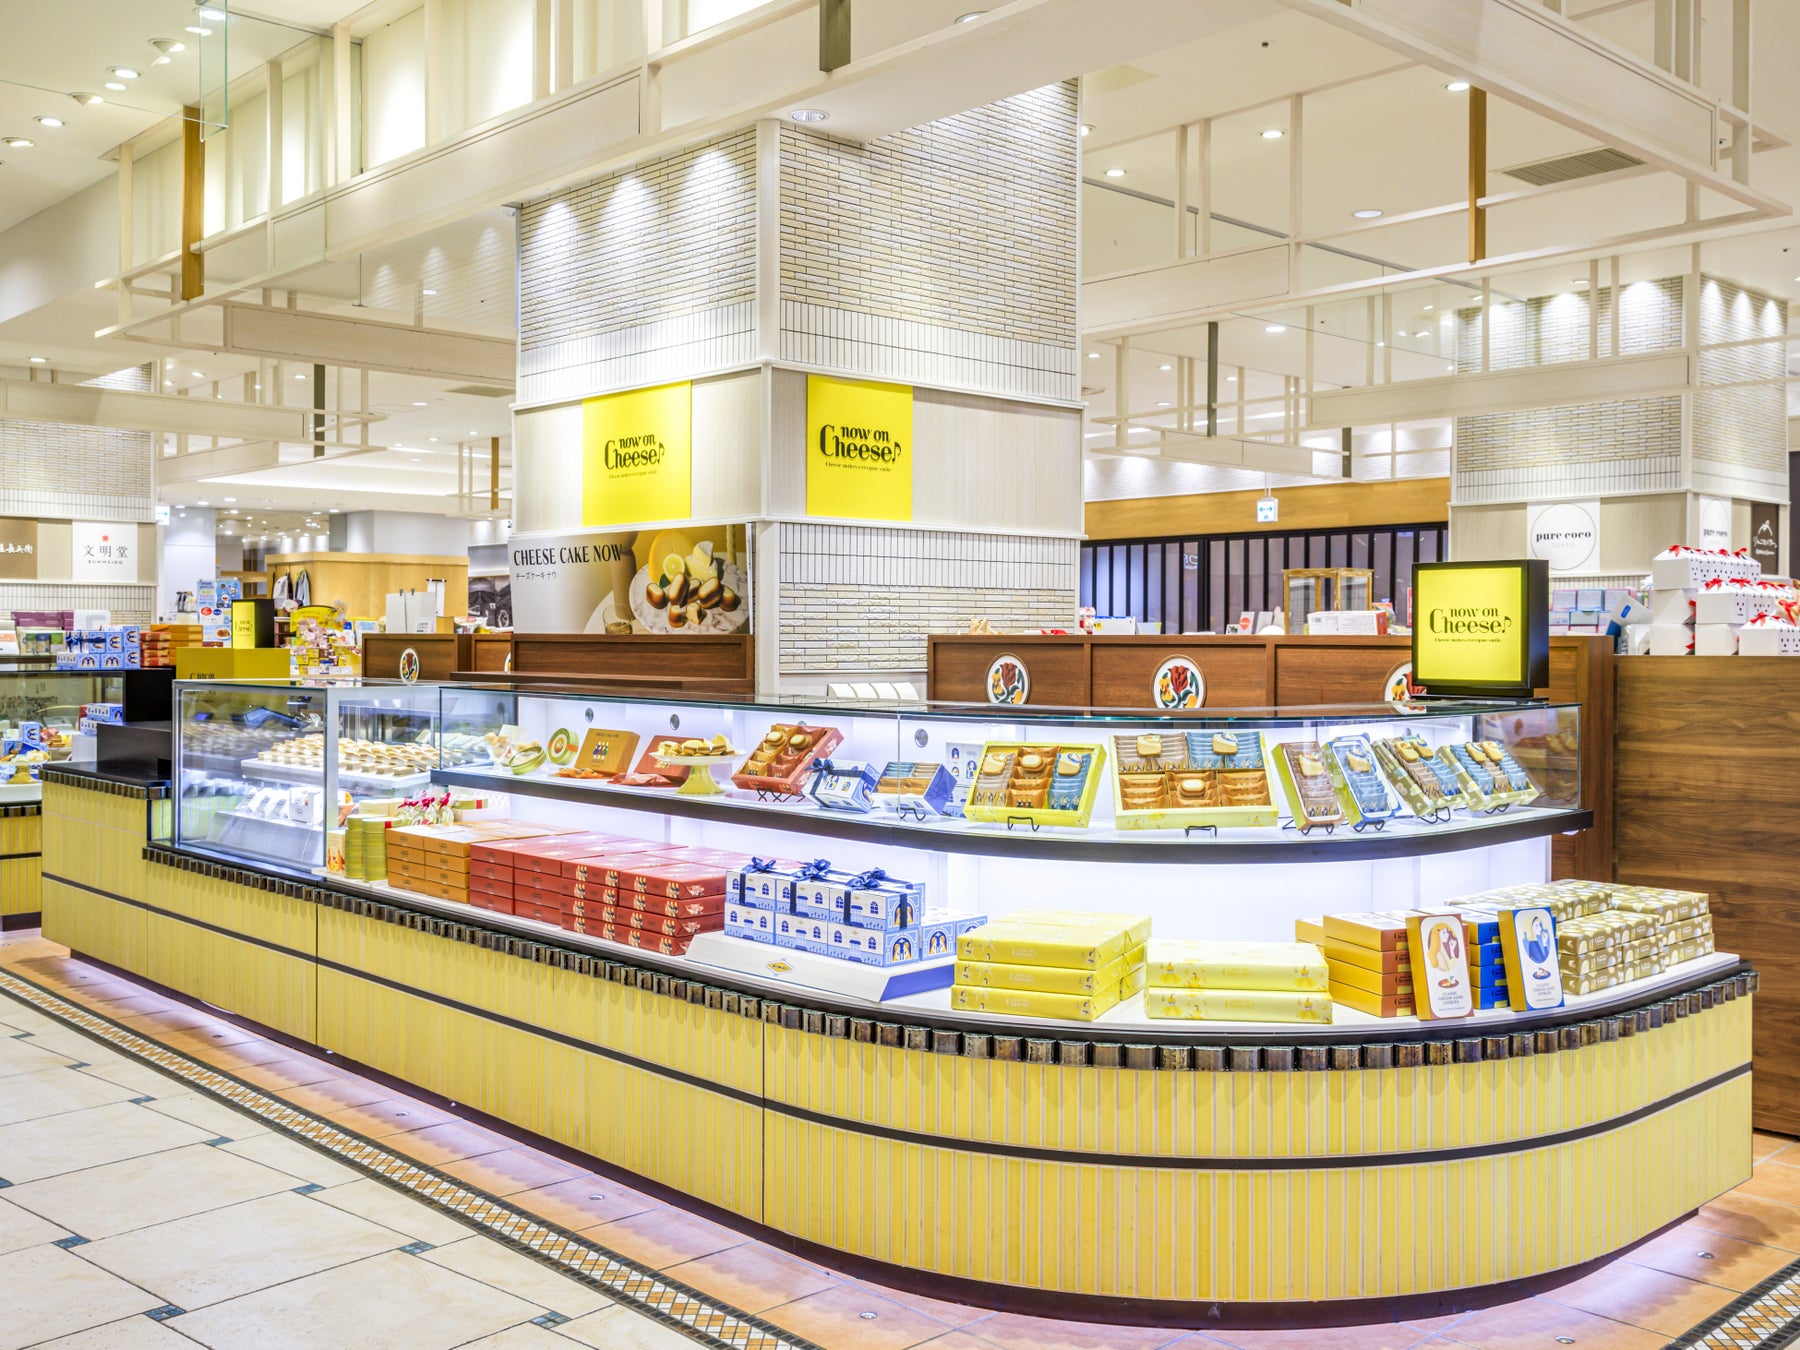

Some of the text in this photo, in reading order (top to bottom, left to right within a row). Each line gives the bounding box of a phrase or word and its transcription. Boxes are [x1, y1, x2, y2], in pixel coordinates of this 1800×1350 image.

[840, 426, 890, 442] now on
[619, 434, 656, 449] now on
[1536, 531, 1592, 543] pure coco
[83, 544, 128, 558] 文明堂
[513, 544, 622, 566] CHEESE CAKE NOW
[1450, 607, 1499, 618] now on
